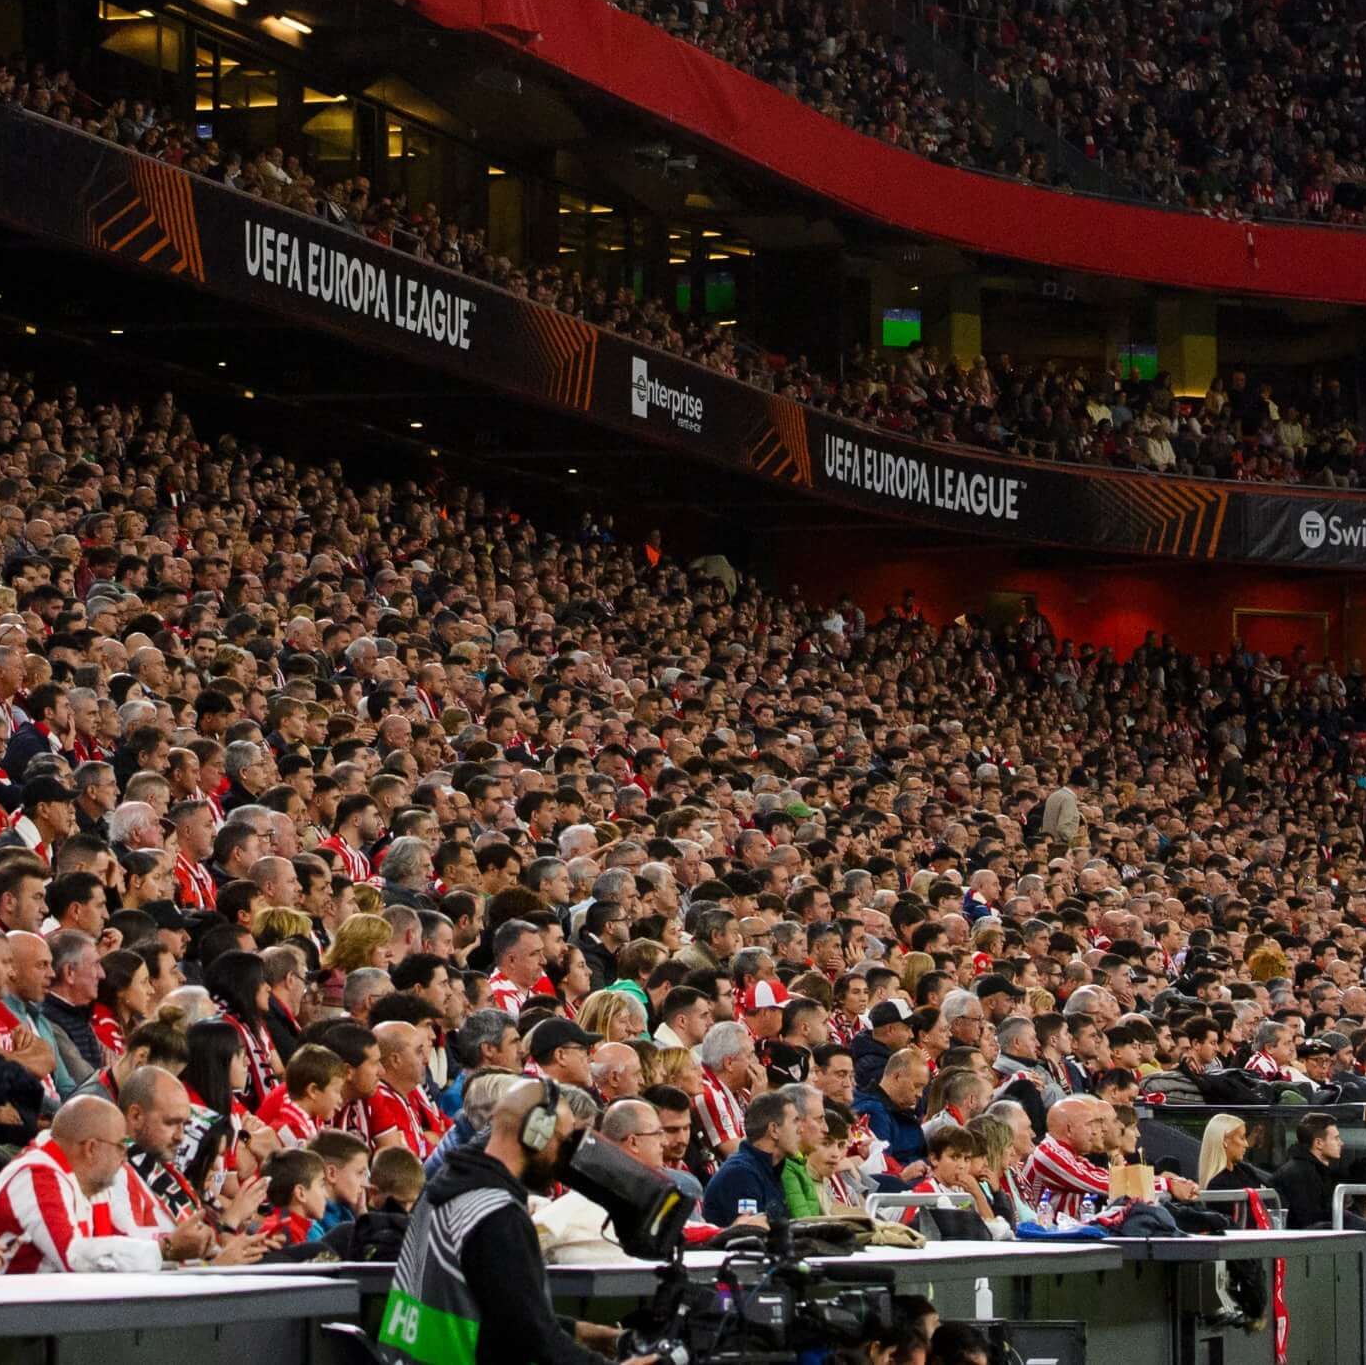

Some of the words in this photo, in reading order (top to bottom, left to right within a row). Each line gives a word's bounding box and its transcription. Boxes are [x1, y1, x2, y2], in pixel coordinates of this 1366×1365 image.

[245, 220, 303, 292] UEFA
[307, 242, 390, 323] EUROPA
[395, 275, 471, 350] LEAGUE
[633, 374, 703, 421] enterprise
[824, 433, 861, 488] UEFA
[864, 447, 931, 504] EUROPA
[934, 465, 1020, 520] LEAGUE
